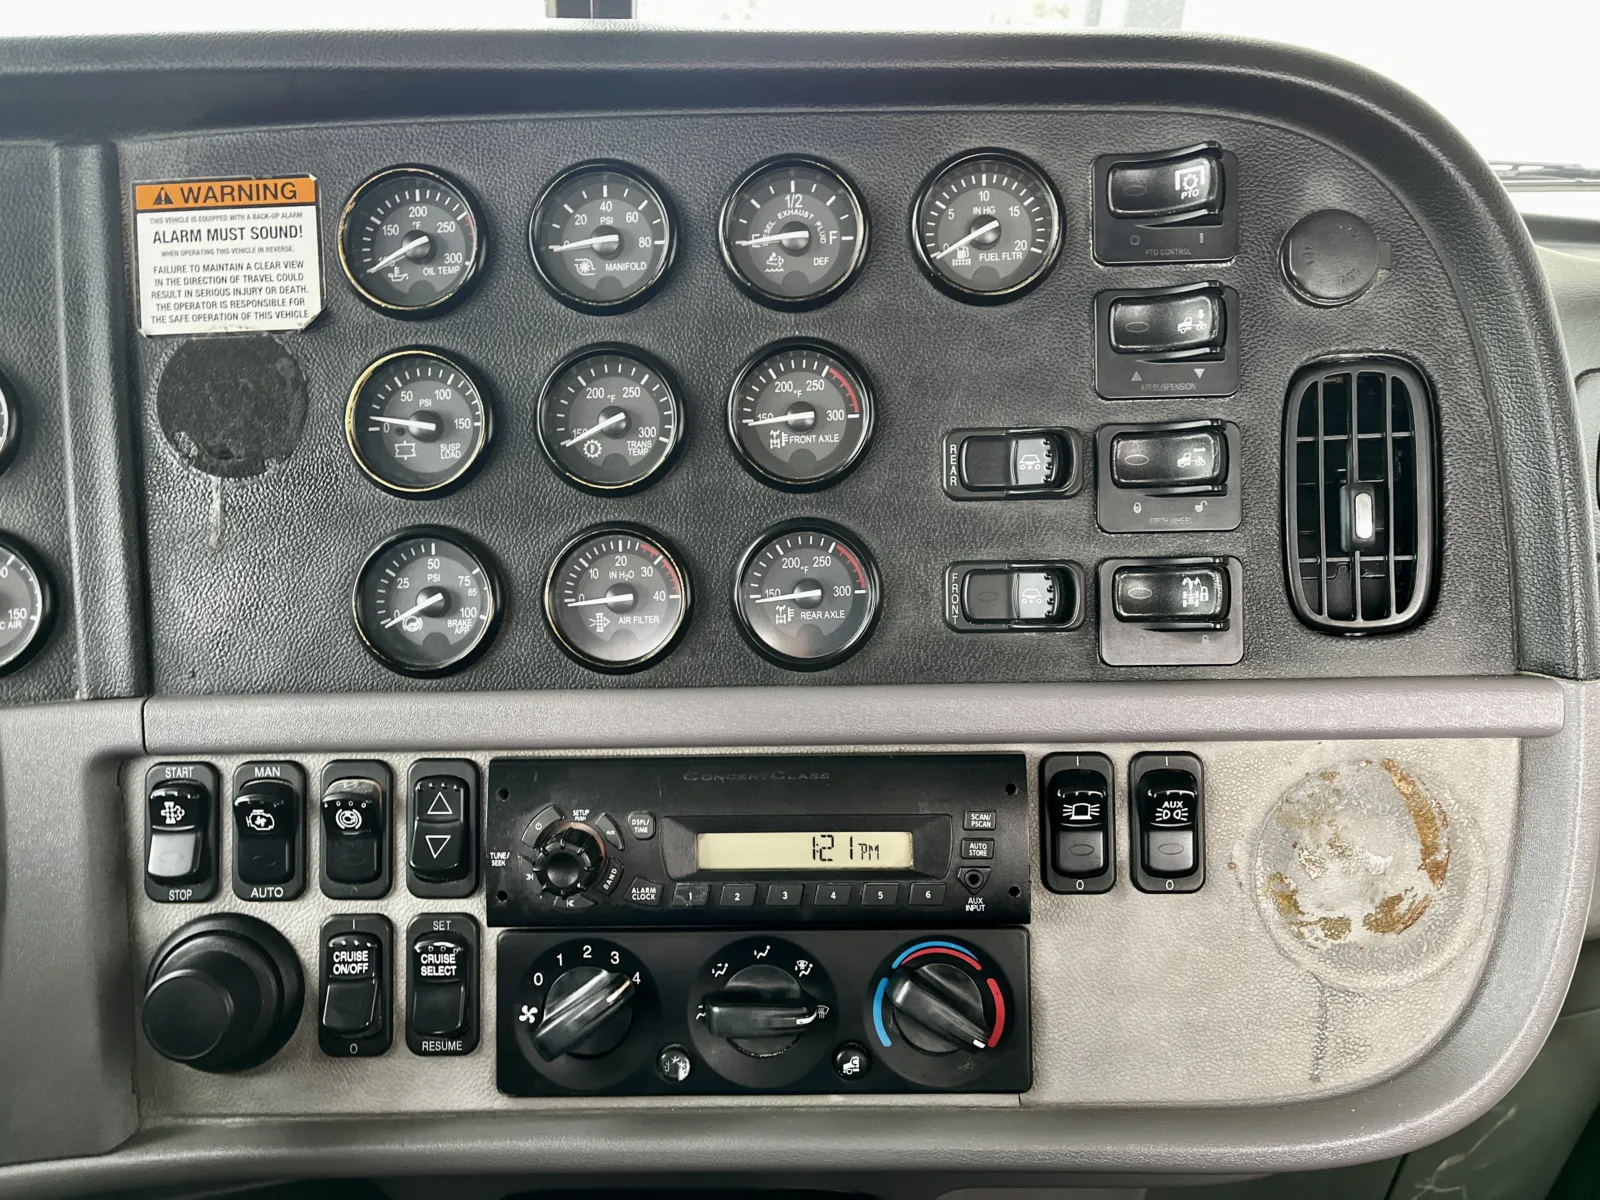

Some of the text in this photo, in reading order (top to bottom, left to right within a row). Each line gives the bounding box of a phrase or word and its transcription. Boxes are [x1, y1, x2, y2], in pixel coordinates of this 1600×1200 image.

[180, 182, 297, 204] WARNING
[979, 191, 990, 201] 10
[1181, 189, 1199, 199] PTO
[600, 201, 612, 211] 40
[785, 194, 802, 208] 1/2
[409, 206, 427, 217] 200
[948, 209, 954, 219] 5
[983, 206, 995, 214] HG
[1009, 206, 1020, 217] 15
[575, 214, 587, 225] 20
[626, 212, 638, 223] 60
[382, 224, 399, 235] 150
[437, 222, 455, 233] 250
[777, 209, 826, 243] EXHAUST FLUID
[153, 224, 303, 244] ALARM MUST SOUND!
[829, 231, 838, 244] F
[639, 237, 651, 248] 80
[1015, 240, 1027, 251] 20
[444, 253, 462, 264] 300
[814, 257, 829, 265] DEF
[980, 252, 1022, 261] FUEL FLTR
[153, 260, 304, 274] FAILURE TO MAINTAIN A CLEAR VIEW
[423, 268, 435, 276] OIL
[605, 262, 646, 271] MANIFOLD
[155, 273, 303, 286] IN THE DIRECTION OF TRAVEL COULD
[151, 285, 308, 300] RESULT IN SERIOUS INJURY OR DEATH.
[156, 298, 305, 312] THE OPERATOR IS RESPONSIBLE FOR
[151, 310, 309, 324] THE SAFE OPERATION OF THIS VEHICLE
[775, 381, 793, 392] 200
[806, 380, 824, 391] 250
[401, 391, 413, 402] 50
[435, 389, 451, 400] 100
[586, 388, 604, 398] 200
[623, 387, 641, 398] 250
[419, 399, 431, 407] PSI
[827, 410, 844, 421] 300
[383, 423, 390, 433] 0
[454, 418, 470, 429] 150
[639, 427, 656, 437] 300
[790, 434, 839, 444] FRONT AXLE
[627, 441, 652, 449] TRANS
[441, 451, 461, 459] LOAD
[949, 444, 957, 485] REAR
[428, 559, 440, 569] 50
[615, 556, 627, 566] 20
[782, 558, 800, 568] 200
[813, 556, 831, 567] 250
[589, 568, 599, 579] 10
[609, 571, 618, 579] IN
[641, 567, 653, 577] 30
[397, 578, 409, 589] 25
[427, 574, 440, 582] PSI
[458, 576, 470, 587] 75
[468, 588, 477, 596] 85
[653, 591, 665, 601] 40
[833, 586, 851, 596] 300
[951, 573, 959, 625] FRONT
[8, 608, 27, 620] 150
[460, 607, 477, 618] 100
[824, 610, 845, 618] AXLE
[8, 621, 22, 629] AIR
[618, 616, 660, 624] AIR FILTER
[165, 767, 194, 778] START
[255, 766, 280, 777] MAN
[812, 835, 880, 862] 1:21 PM
[490, 852, 510, 860] TUNE/
[603, 868, 618, 890] BAND
[169, 890, 192, 901] STOP
[251, 887, 284, 898] AUTO
[688, 892, 693, 900] 1
[782, 892, 788, 900] 3
[878, 891, 883, 899] 5
[433, 921, 451, 930] SET
[333, 951, 368, 962] CRUISE
[583, 946, 592, 958] 2
[610, 951, 620, 964] 3
[421, 954, 456, 964] CRUISE
[556, 954, 563, 966] 1
[333, 963, 368, 974] ON/OFF
[421, 966, 457, 976] SELECT
[534, 973, 543, 985] 0
[632, 972, 641, 985] 4
[422, 1041, 462, 1051] RESUME
